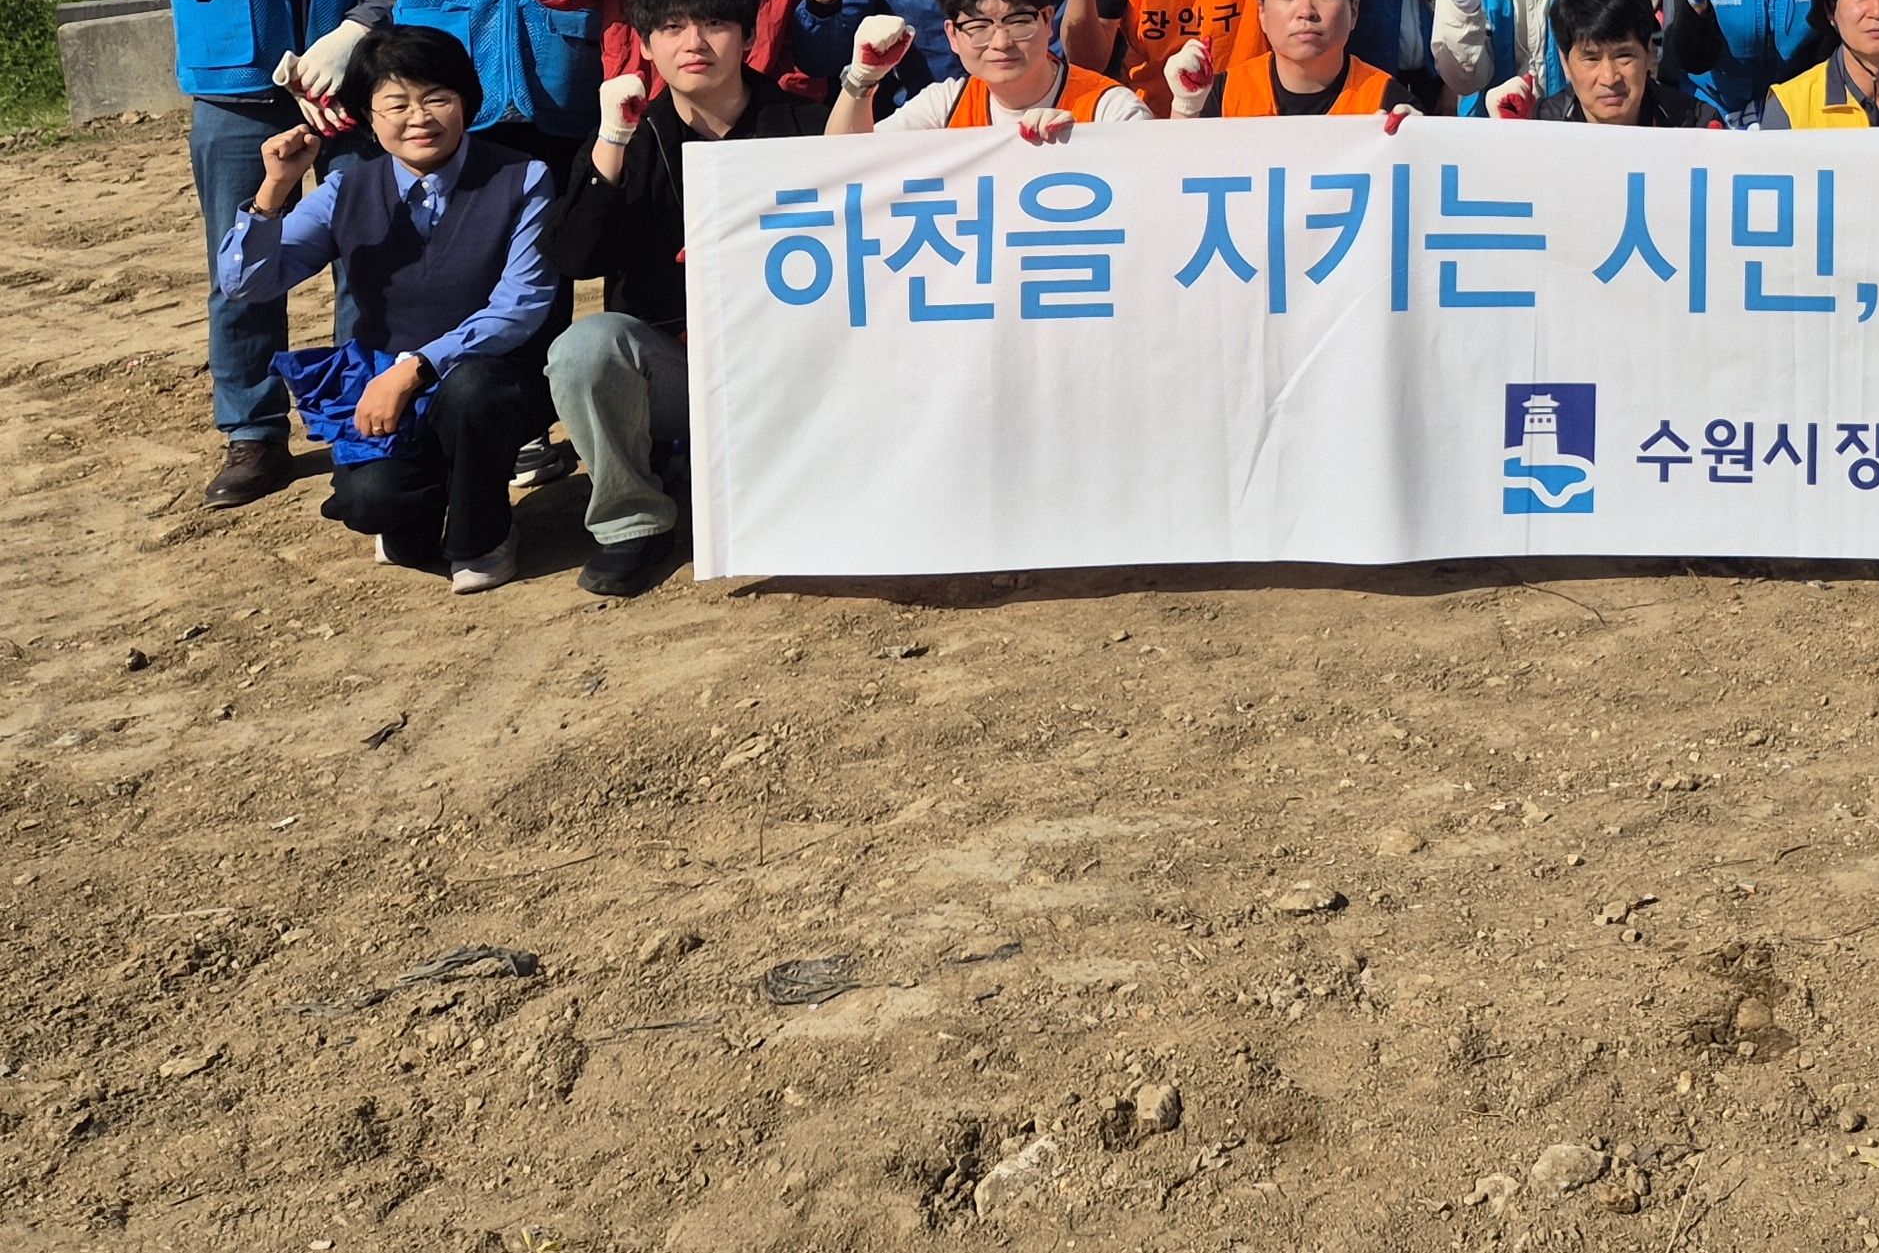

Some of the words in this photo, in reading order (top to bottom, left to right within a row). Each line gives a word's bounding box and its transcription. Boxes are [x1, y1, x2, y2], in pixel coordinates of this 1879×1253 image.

[759, 171, 1126, 327] 하천을
[1174, 164, 1547, 314] 지키는
[1593, 167, 1879, 322] 시민,
[1636, 418, 1818, 485] 수원시
